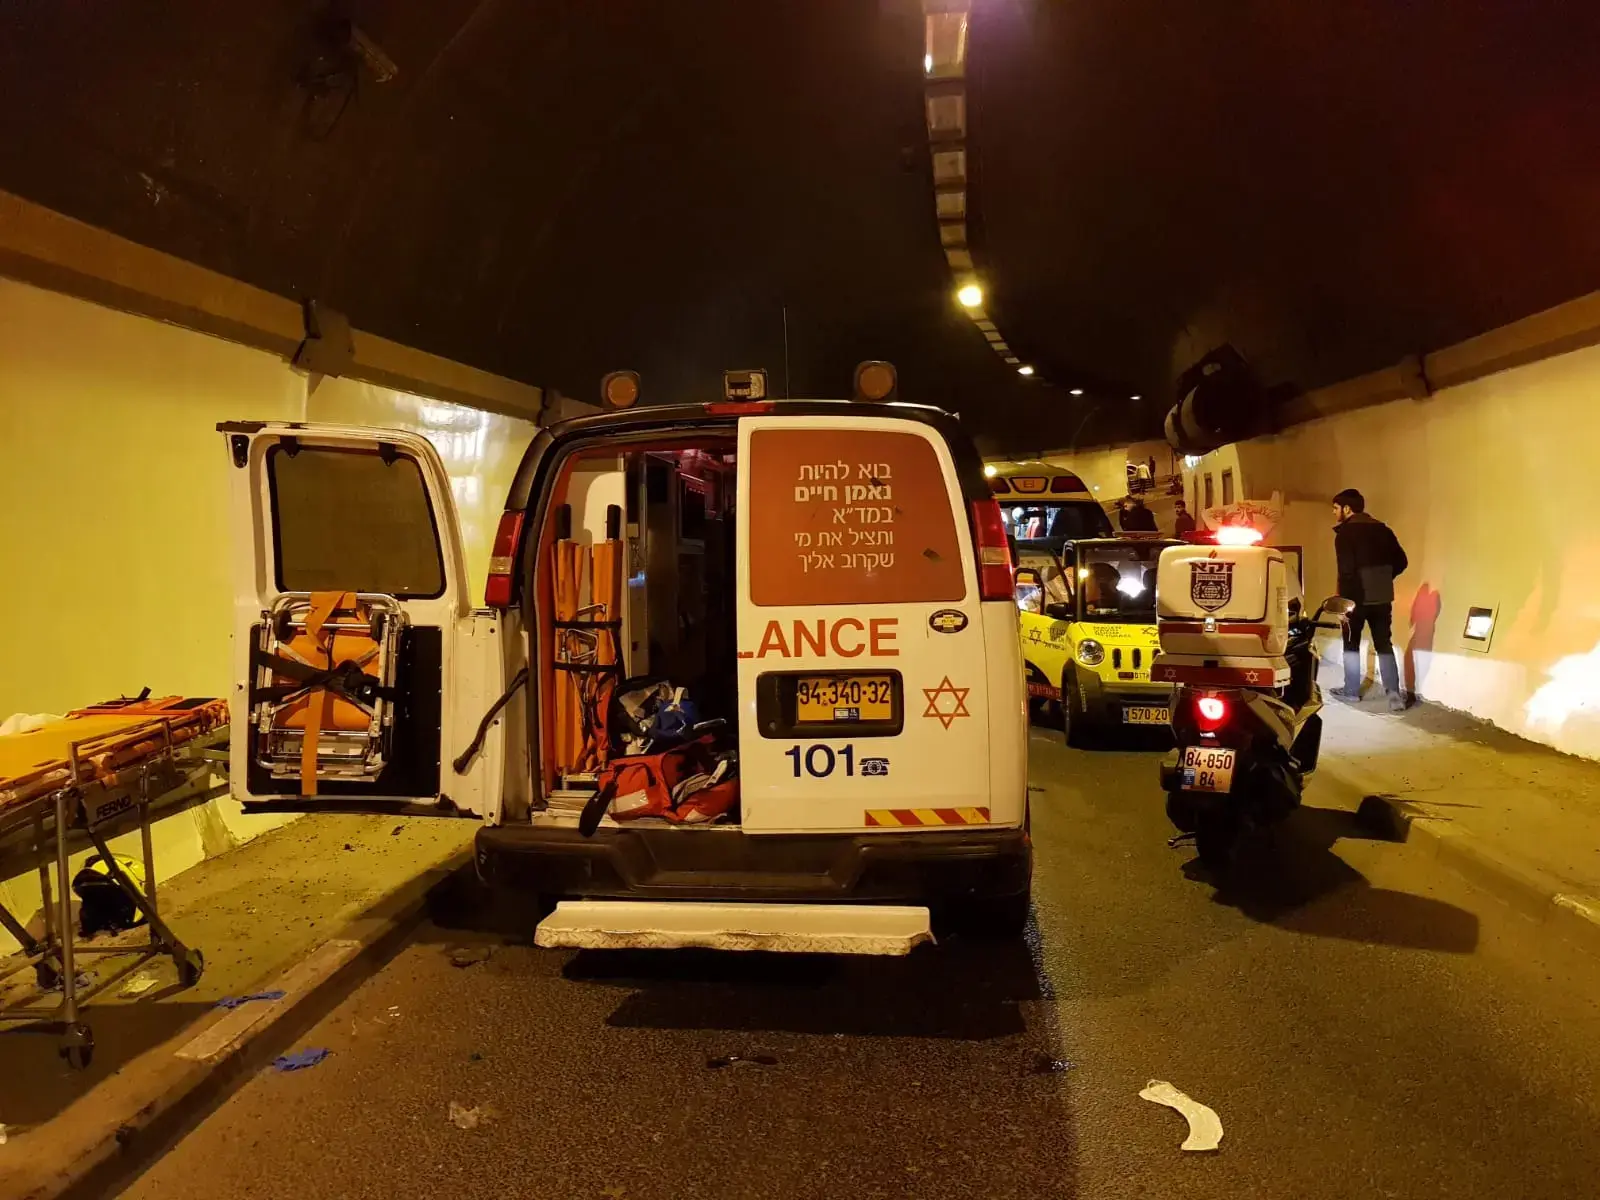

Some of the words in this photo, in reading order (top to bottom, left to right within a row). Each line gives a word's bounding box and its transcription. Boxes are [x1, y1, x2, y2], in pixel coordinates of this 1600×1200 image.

[798, 459, 850, 481] להיות
[858, 463, 892, 480] בוא
[794, 485, 838, 502] חיים
[844, 484, 892, 505] נאמן
[794, 532, 812, 547] מי
[817, 531, 843, 547] את
[848, 528, 894, 546] ותציל
[798, 551, 835, 573] אליך
[840, 552, 894, 573] שקרוב
[737, 617, 900, 659] ANCE
[785, 744, 854, 777] 101
[1200, 771, 1215, 785] 84
[96, 793, 132, 818] FERNO
